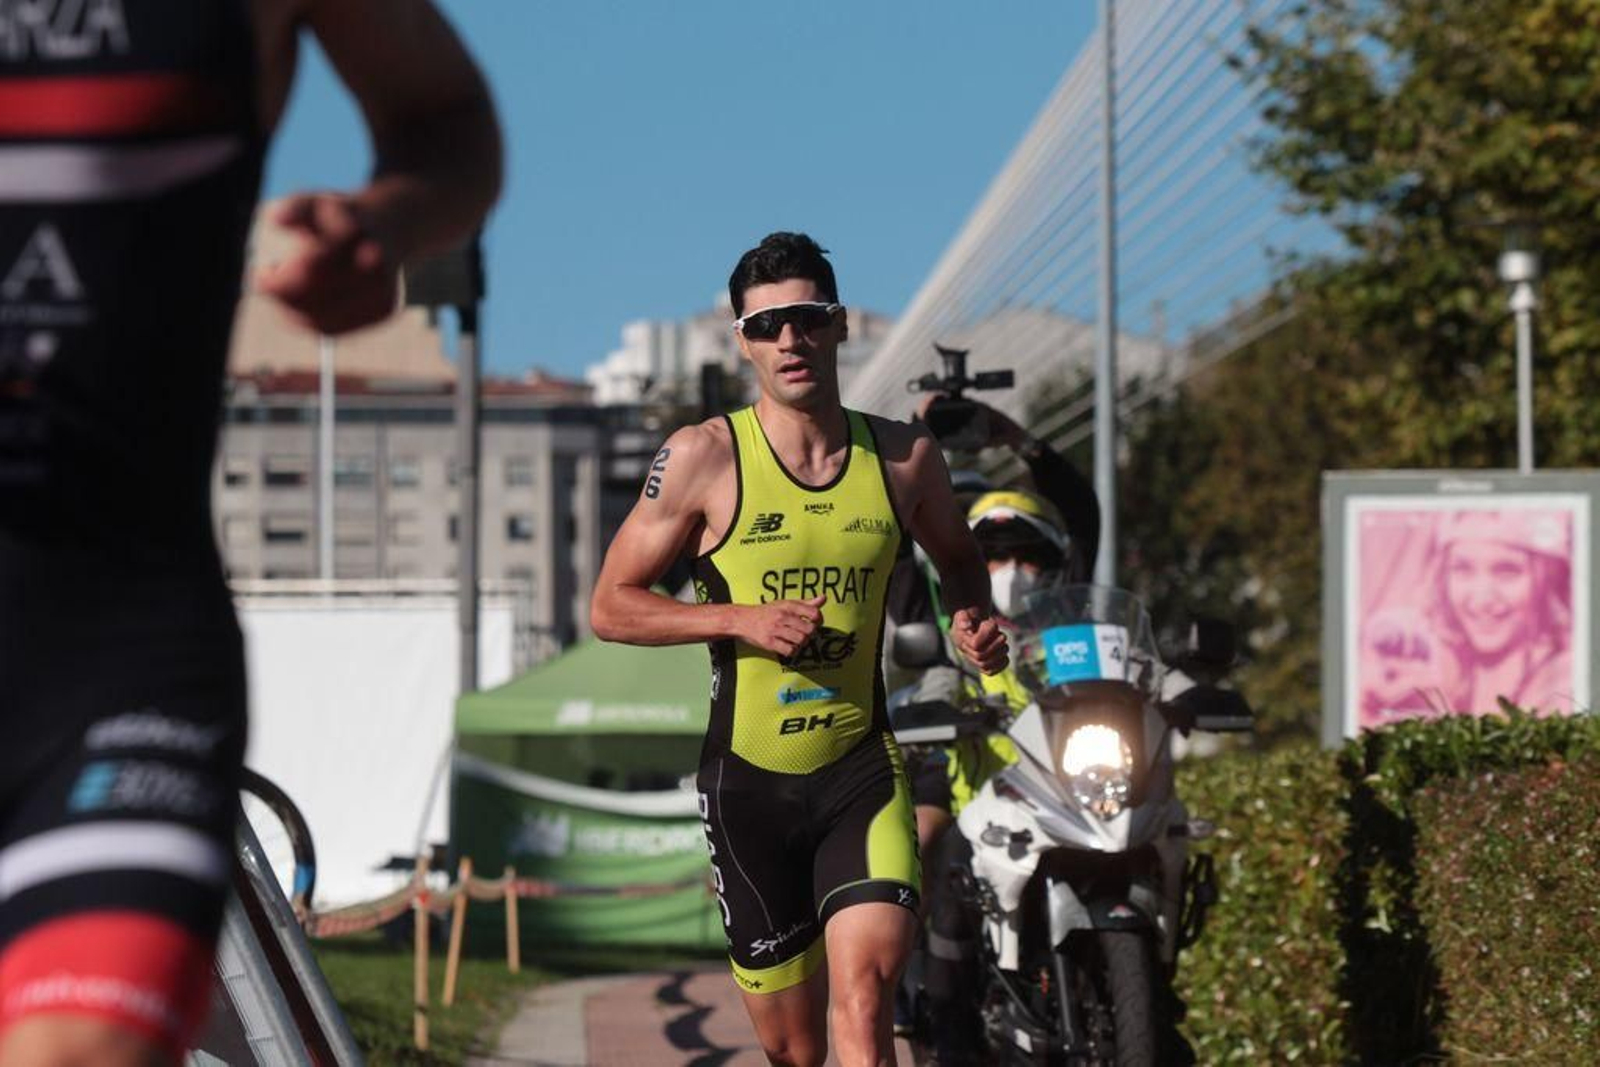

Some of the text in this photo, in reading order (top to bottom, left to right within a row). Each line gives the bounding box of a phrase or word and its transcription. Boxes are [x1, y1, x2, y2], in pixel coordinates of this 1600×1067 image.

[645, 447, 671, 500] 26
[740, 533, 791, 546] new balance
[760, 566, 875, 604] SERRAT
[1110, 646, 1121, 662] 4
[779, 713, 835, 735] BH
